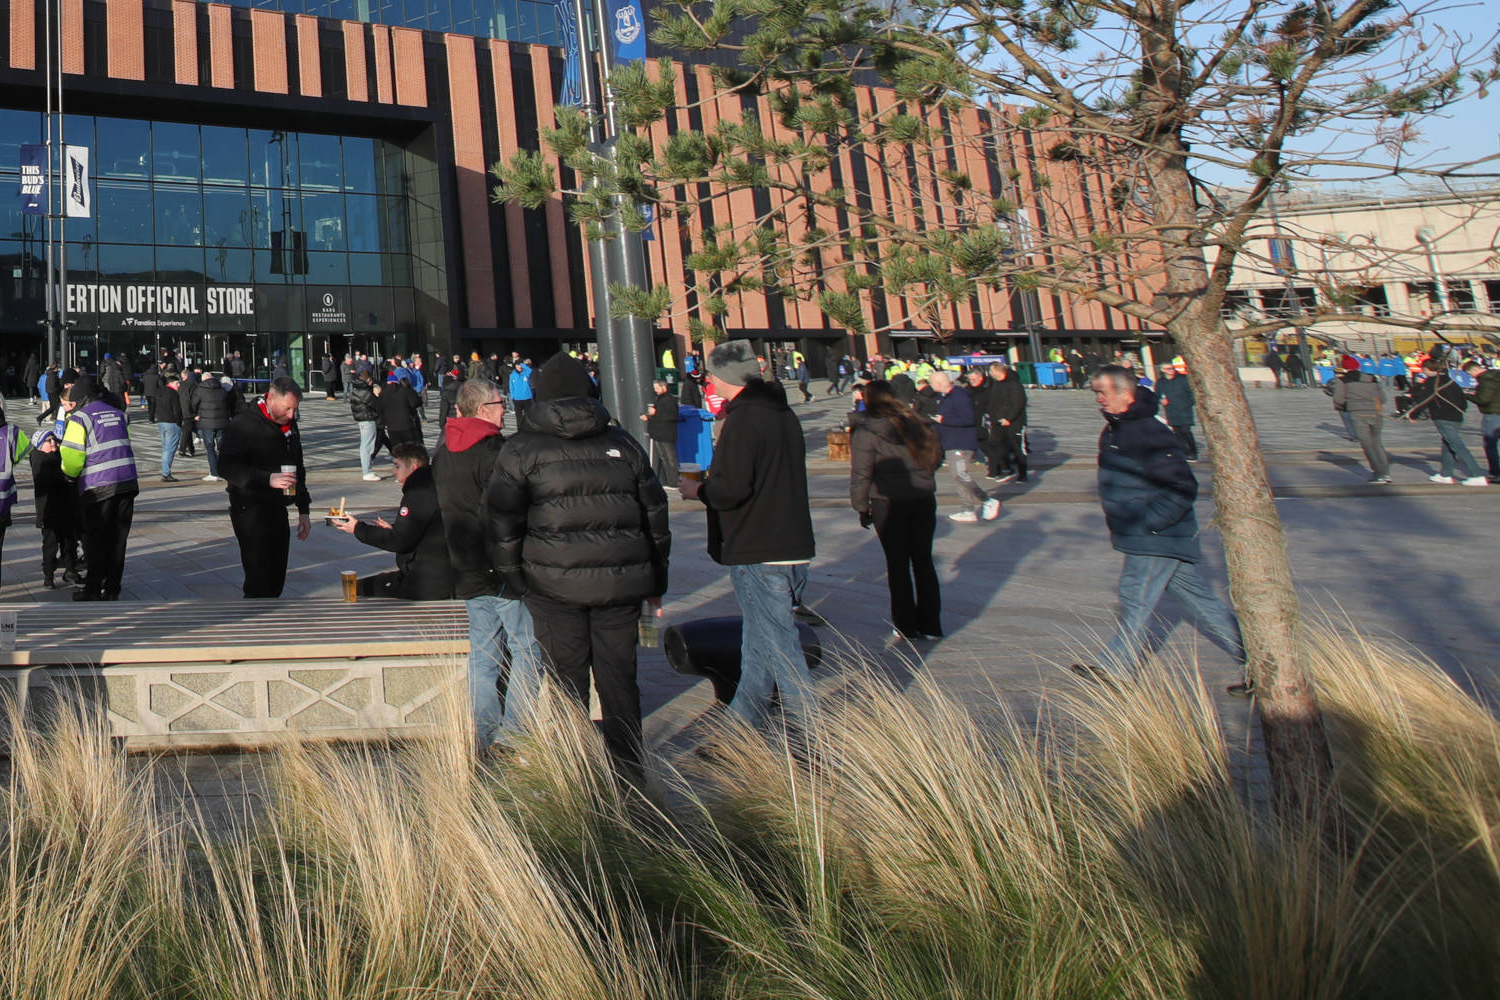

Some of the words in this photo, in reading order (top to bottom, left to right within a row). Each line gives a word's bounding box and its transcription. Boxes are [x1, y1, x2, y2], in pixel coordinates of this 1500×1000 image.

[21, 165, 40, 175] THIS
[21, 175, 45, 185] BUD'S
[72, 160, 82, 203] Budweiser
[21, 185, 42, 195] BLUE
[126, 285, 199, 315] OFFICIAL
[206, 287, 254, 315] STORE
[157, 319, 185, 328] Experience
